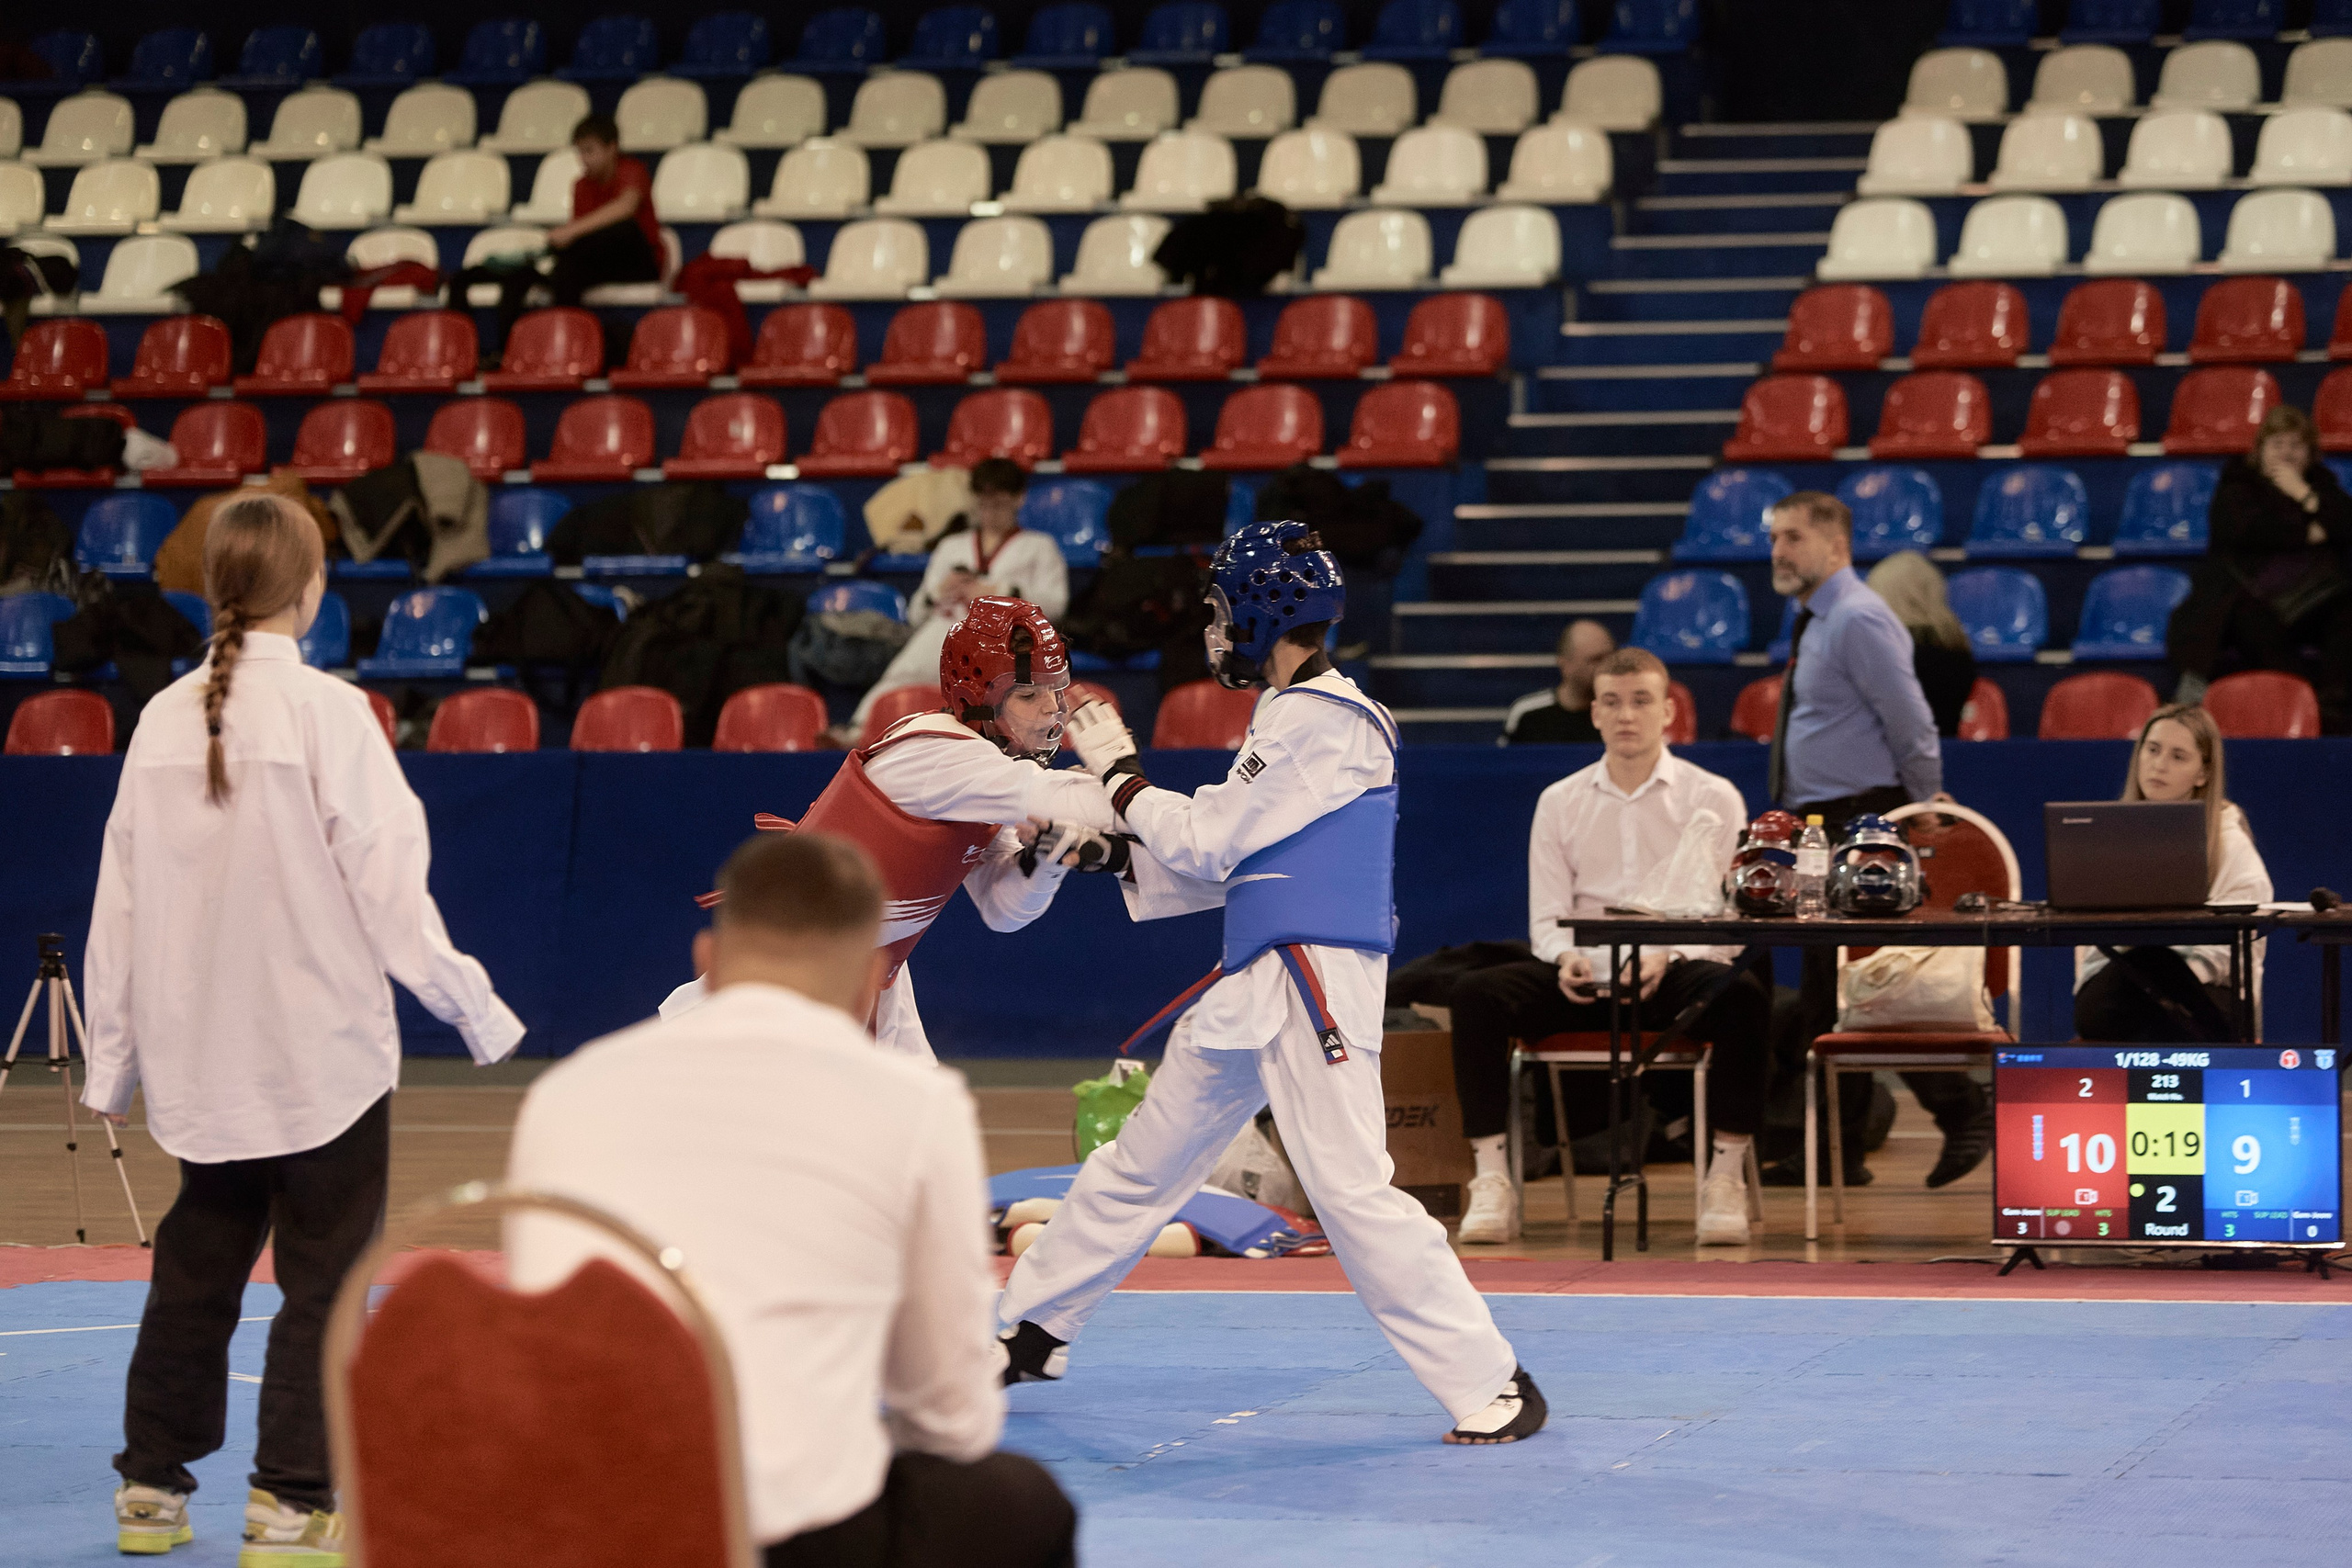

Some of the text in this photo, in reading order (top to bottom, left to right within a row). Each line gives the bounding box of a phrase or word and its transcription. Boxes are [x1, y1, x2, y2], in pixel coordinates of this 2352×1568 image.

[2114, 1052, 2210, 1068] 1/128 -49KG
[2078, 1077, 2094, 1098] 2
[2151, 1074, 2180, 1089] 213
[2239, 1078, 2251, 1099] 1
[2132, 1131, 2200, 1157] 0:19
[2059, 1133, 2117, 1174] 10
[2231, 1134, 2262, 1175] 9
[2154, 1185, 2177, 1213] 2
[2017, 1222, 2029, 1235] 3
[2098, 1222, 2109, 1236] 3
[2144, 1223, 2188, 1237] Round
[2223, 1224, 2235, 1237] 3
[2306, 1224, 2318, 1238] 0
